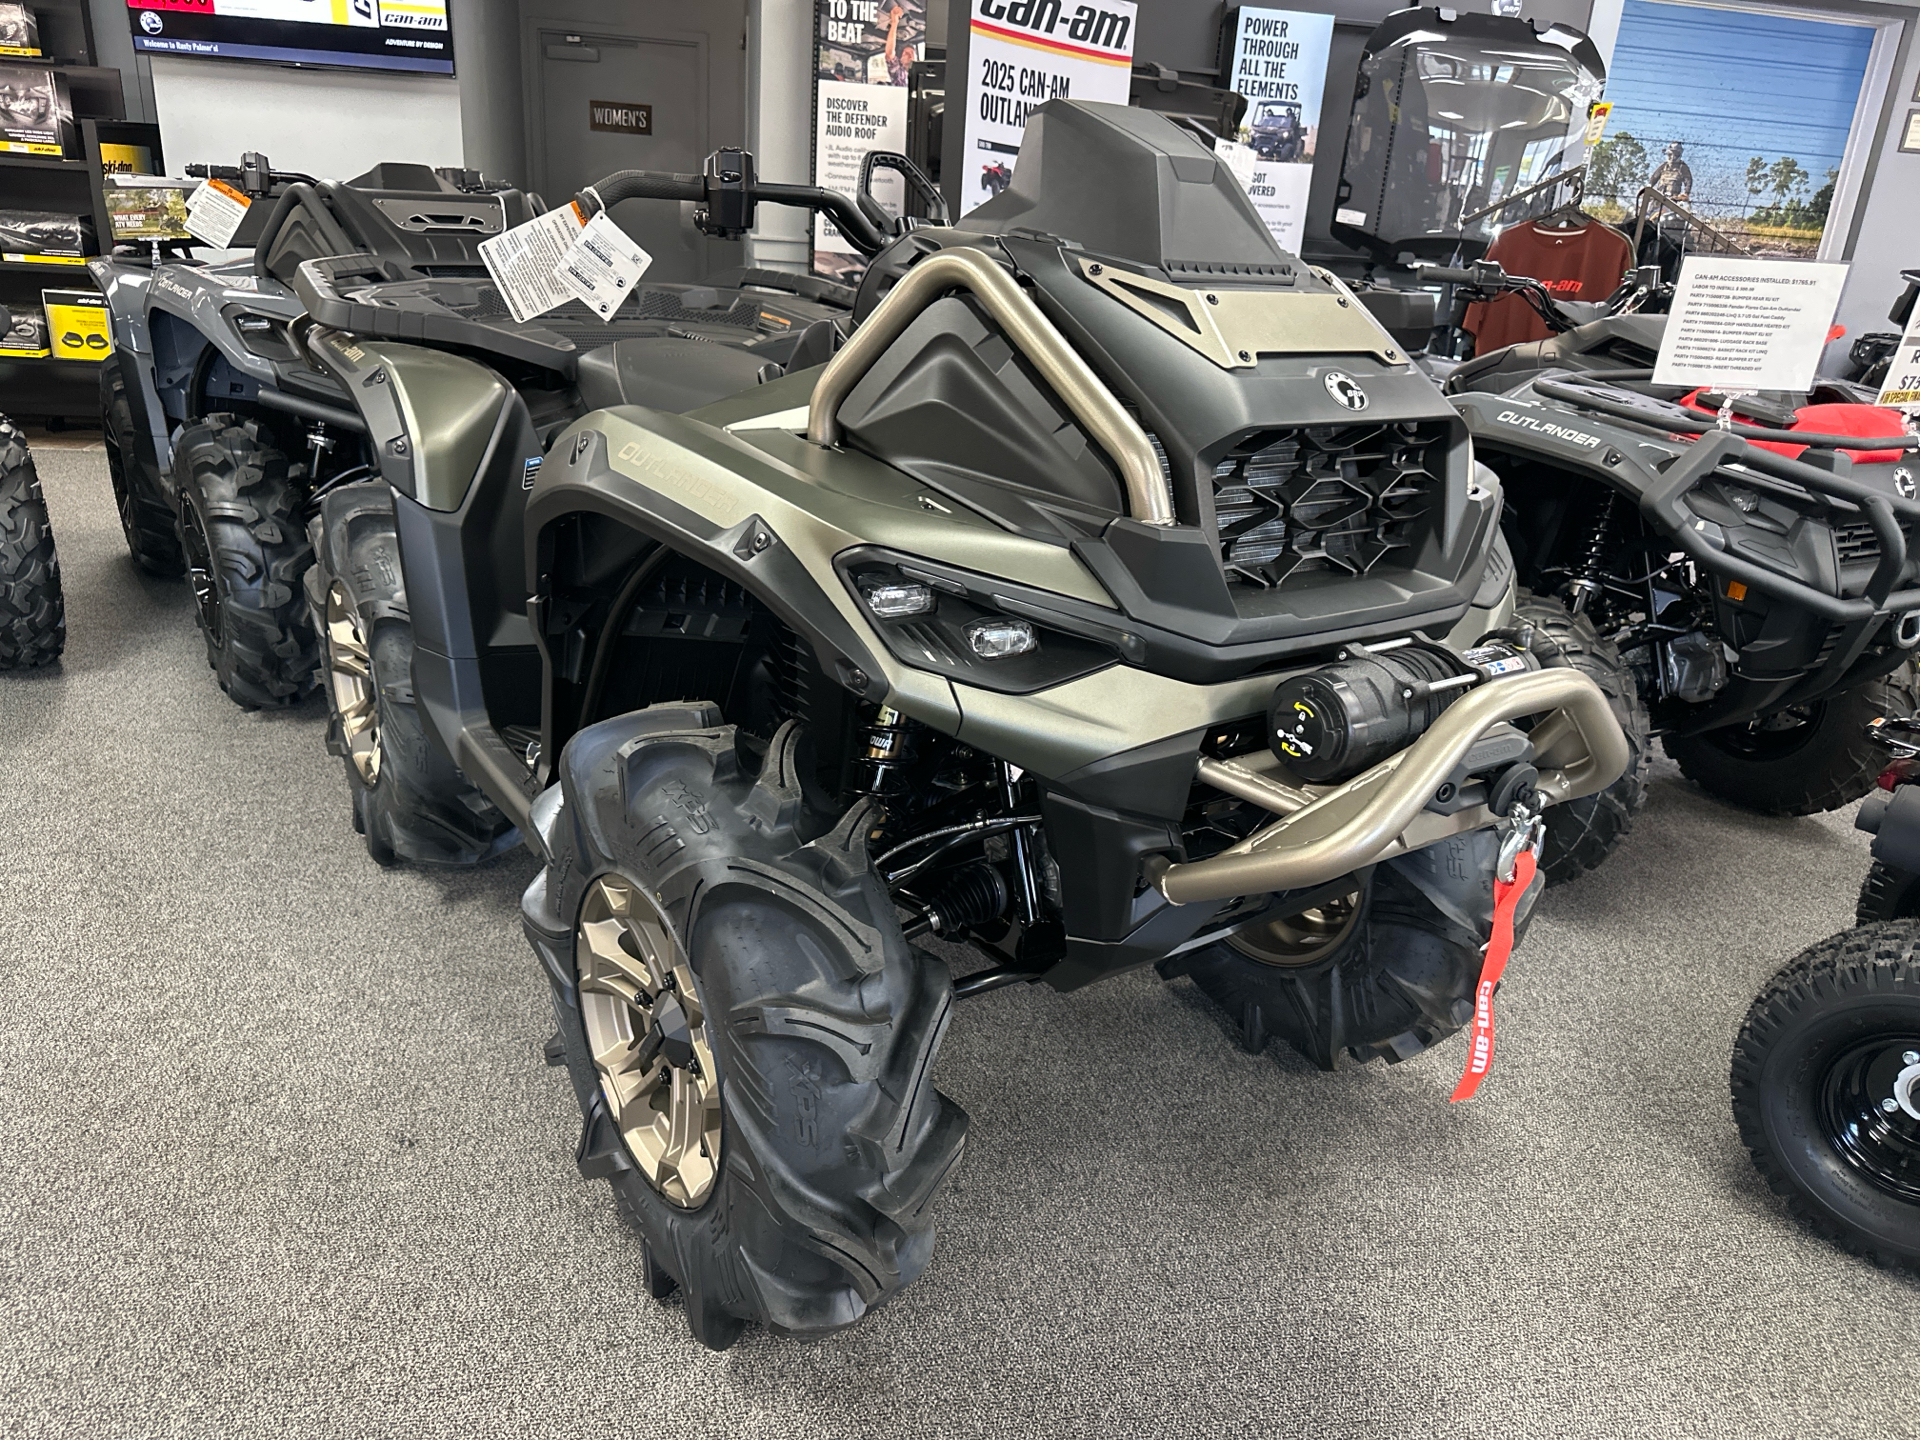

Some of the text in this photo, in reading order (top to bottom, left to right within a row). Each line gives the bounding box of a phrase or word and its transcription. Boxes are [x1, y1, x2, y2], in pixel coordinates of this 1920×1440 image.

[384, 13, 443, 27] can-am
[828, 0, 879, 23] TO THE
[828, 21, 865, 44] BEAT
[1244, 17, 1289, 38] POWER
[1242, 37, 1299, 60] THROUGH
[981, 58, 1071, 99] 2025 CAN-AM
[1238, 58, 1287, 79] ALL THE
[1237, 78, 1299, 100] ELEMENTS
[826, 97, 869, 111] DISCOVER
[980, 92, 1034, 129] OUTLAN
[593, 107, 647, 129] WOMEN'S
[826, 110, 888, 127] THE DEFENDER
[825, 125, 877, 140] AUDIO ROOF
[1248, 185, 1276, 197] VERED
[1694, 273, 1719, 281] CAN-AM
[1719, 275, 1760, 283] ACCESSORIES
[1496, 410, 1602, 449] OUTLANDER
[617, 441, 740, 514] OUTLANDER
[1470, 980, 1493, 1074] can-am
